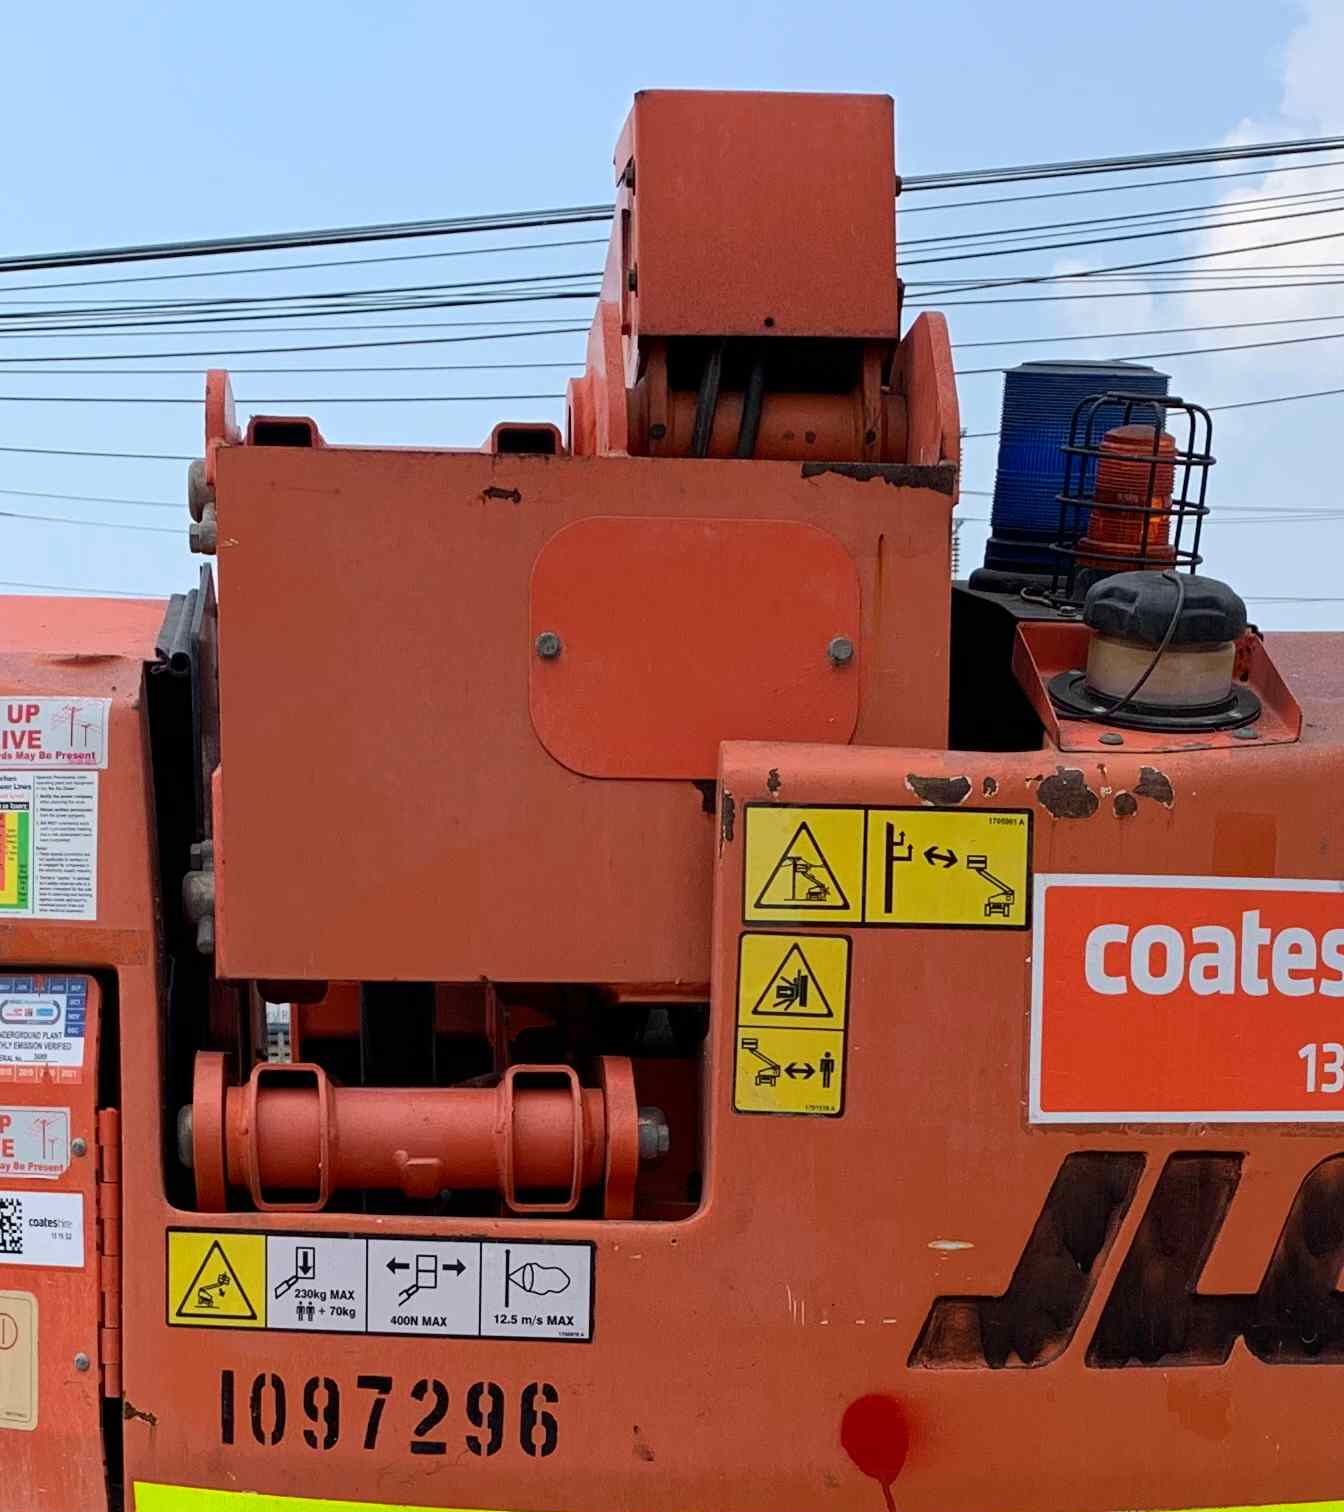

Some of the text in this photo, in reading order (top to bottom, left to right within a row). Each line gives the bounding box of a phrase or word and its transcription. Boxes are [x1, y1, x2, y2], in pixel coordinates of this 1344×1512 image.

[7, 704, 40, 724] UP
[15, 751, 37, 762] May
[38, 751, 53, 760] Be
[55, 751, 97, 761] Present
[1297, 1043, 1344, 1094] 13
[13, 1161, 27, 1171] Be
[28, 1162, 64, 1172] Present
[294, 1288, 355, 1302] 230kg MAX
[329, 1305, 356, 1319] 70kg
[390, 1315, 448, 1327] 400N MAX
[493, 1314, 575, 1327] 12.5 m/s MAX
[221, 1369, 560, 1458] 1097296
